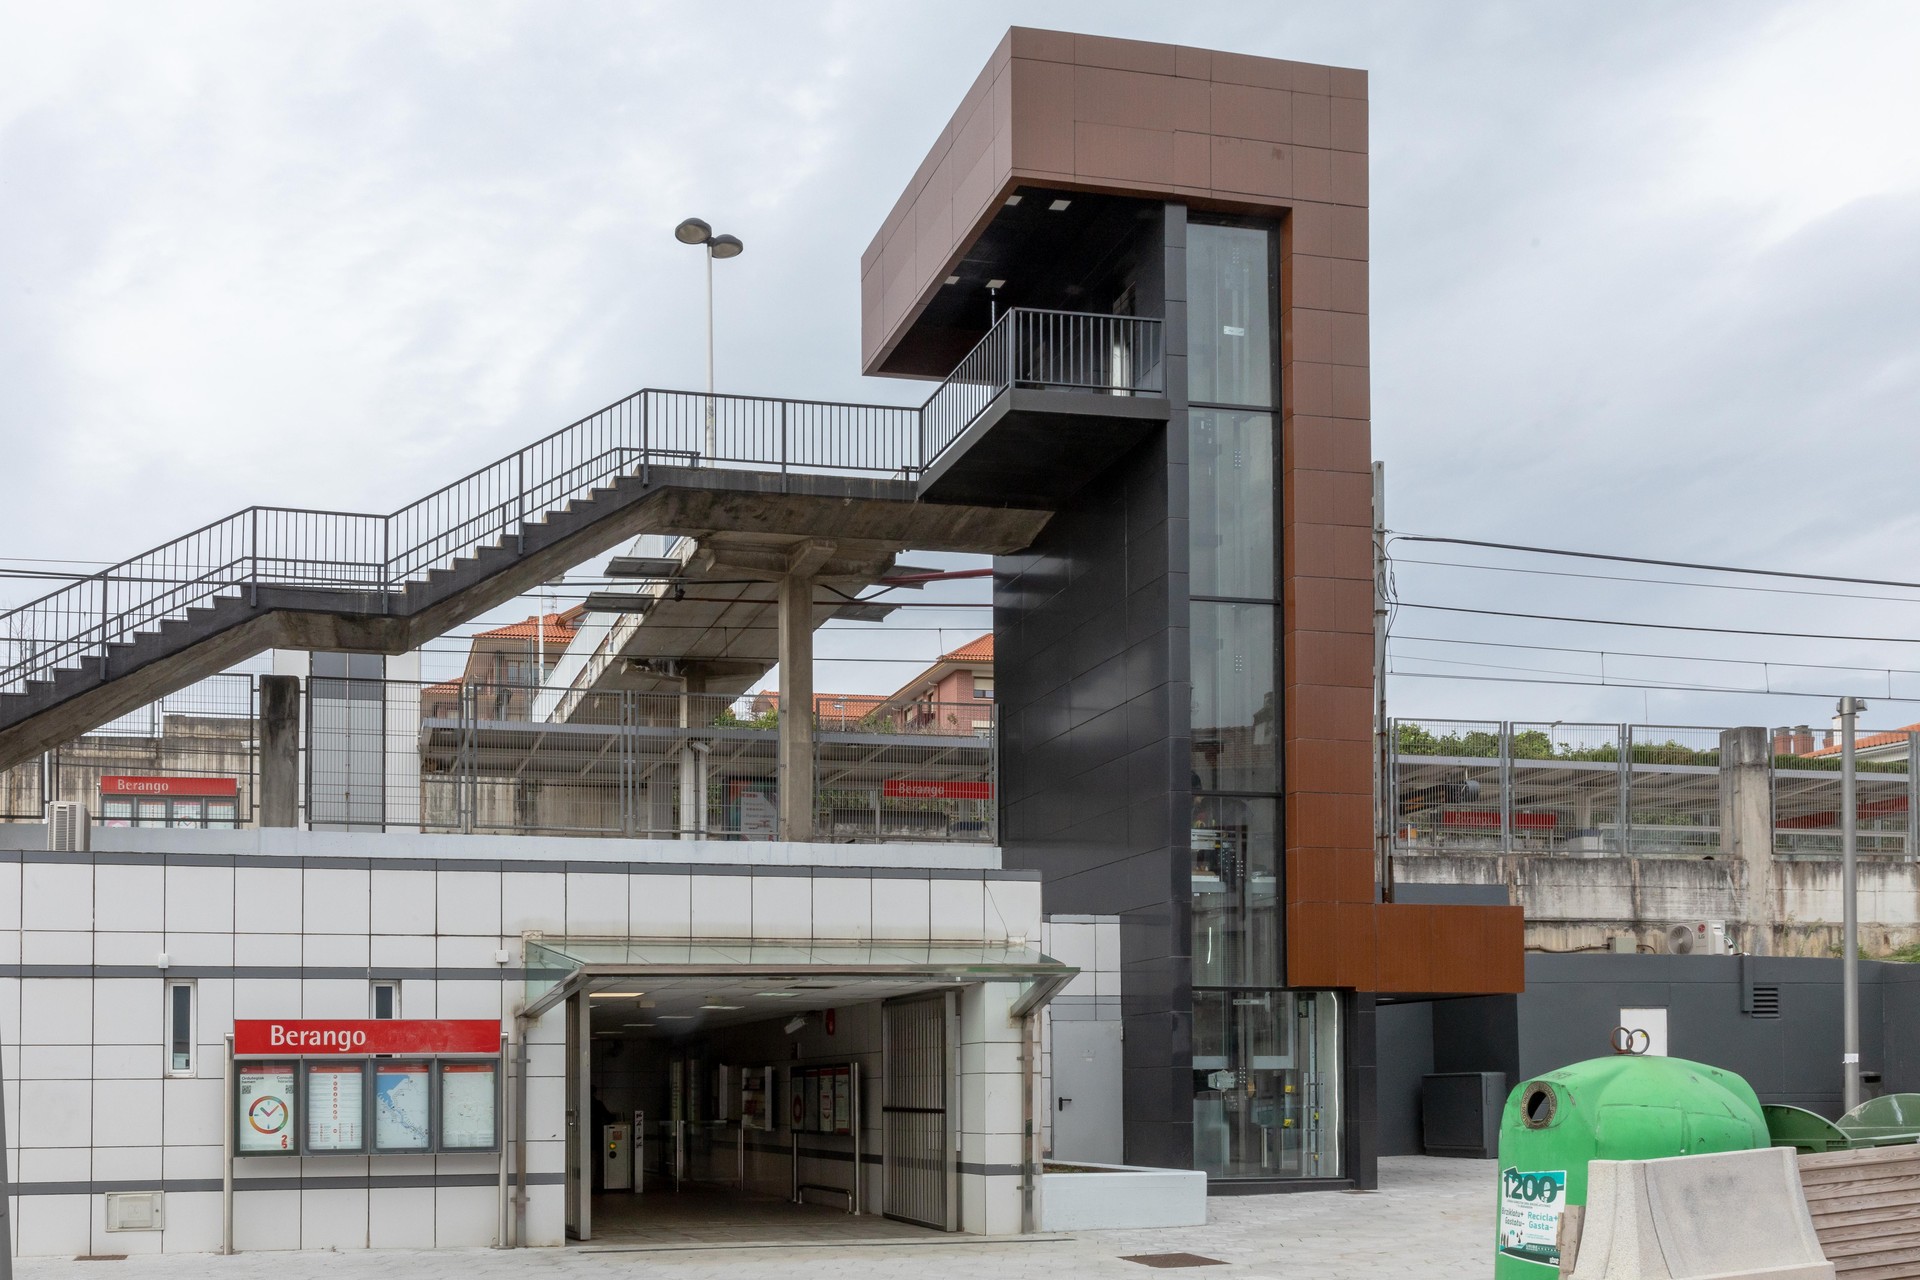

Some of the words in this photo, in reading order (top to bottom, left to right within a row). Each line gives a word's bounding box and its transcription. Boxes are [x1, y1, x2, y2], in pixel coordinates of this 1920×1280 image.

[117, 779, 169, 794] Berango
[898, 782, 945, 796] Berango
[270, 1024, 366, 1051] Berango
[1528, 1212, 1558, 1221] Recicla+
[1529, 1221, 1553, 1230] Gasta-
